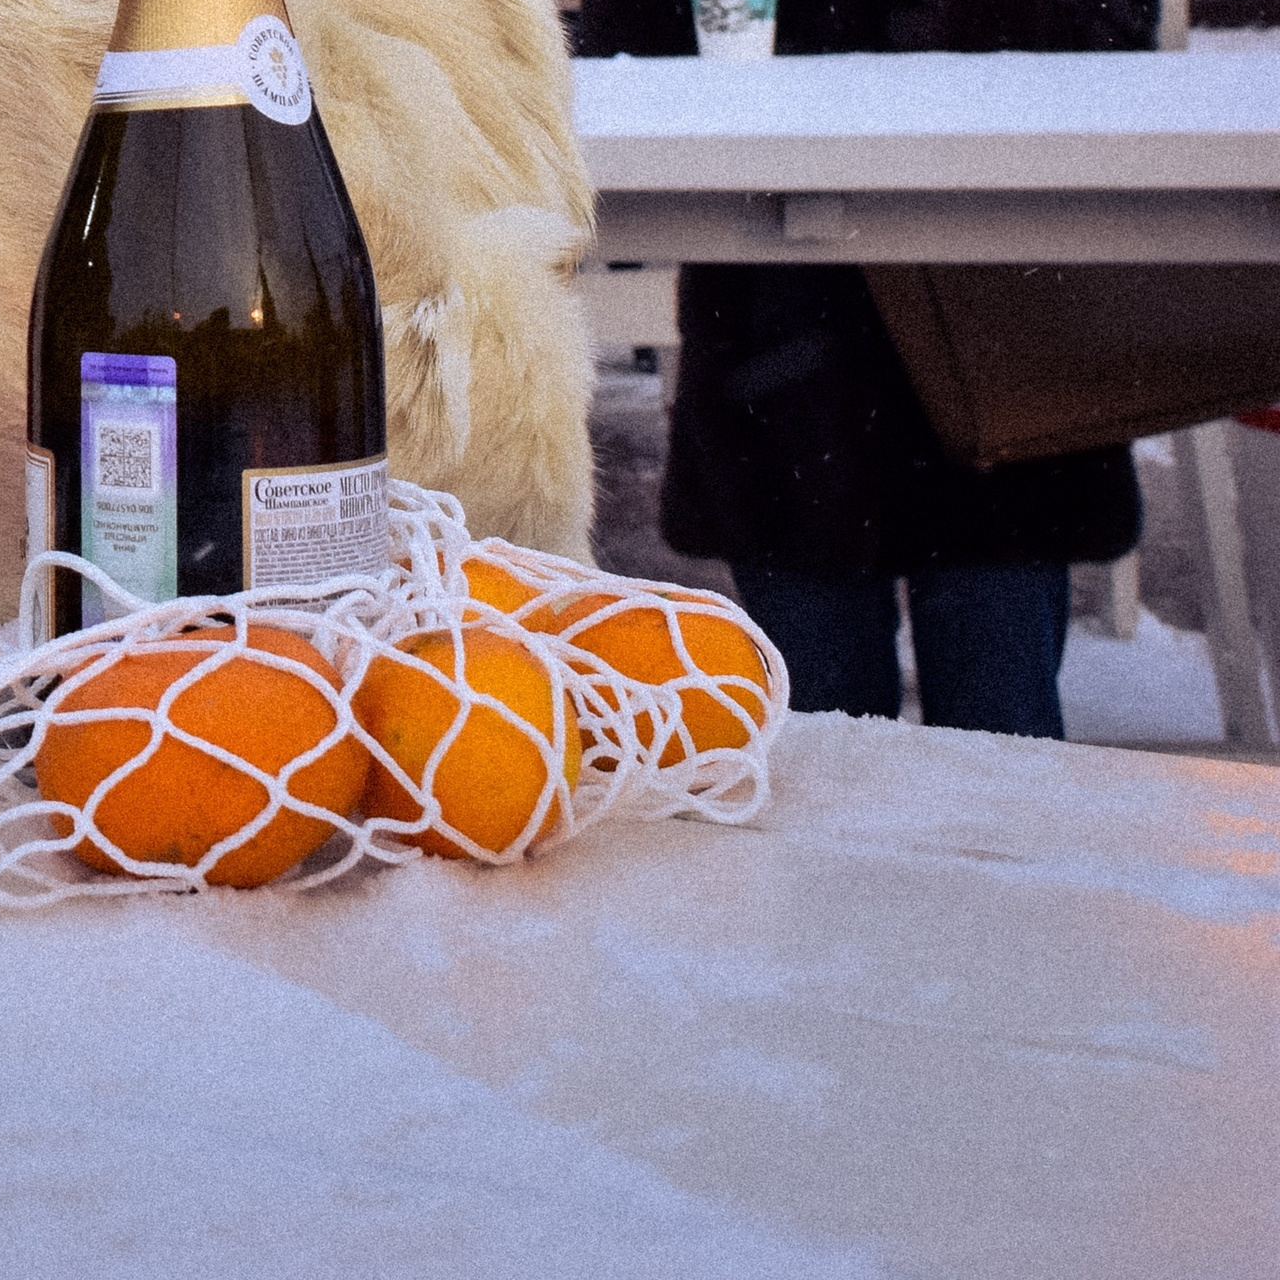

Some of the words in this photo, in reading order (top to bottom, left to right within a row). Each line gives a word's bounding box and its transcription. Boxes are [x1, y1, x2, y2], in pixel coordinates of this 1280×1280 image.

[254, 477, 332, 504] Советское
[340, 472, 370, 497] МЕСТО
[265, 498, 329, 510] Шампанское
